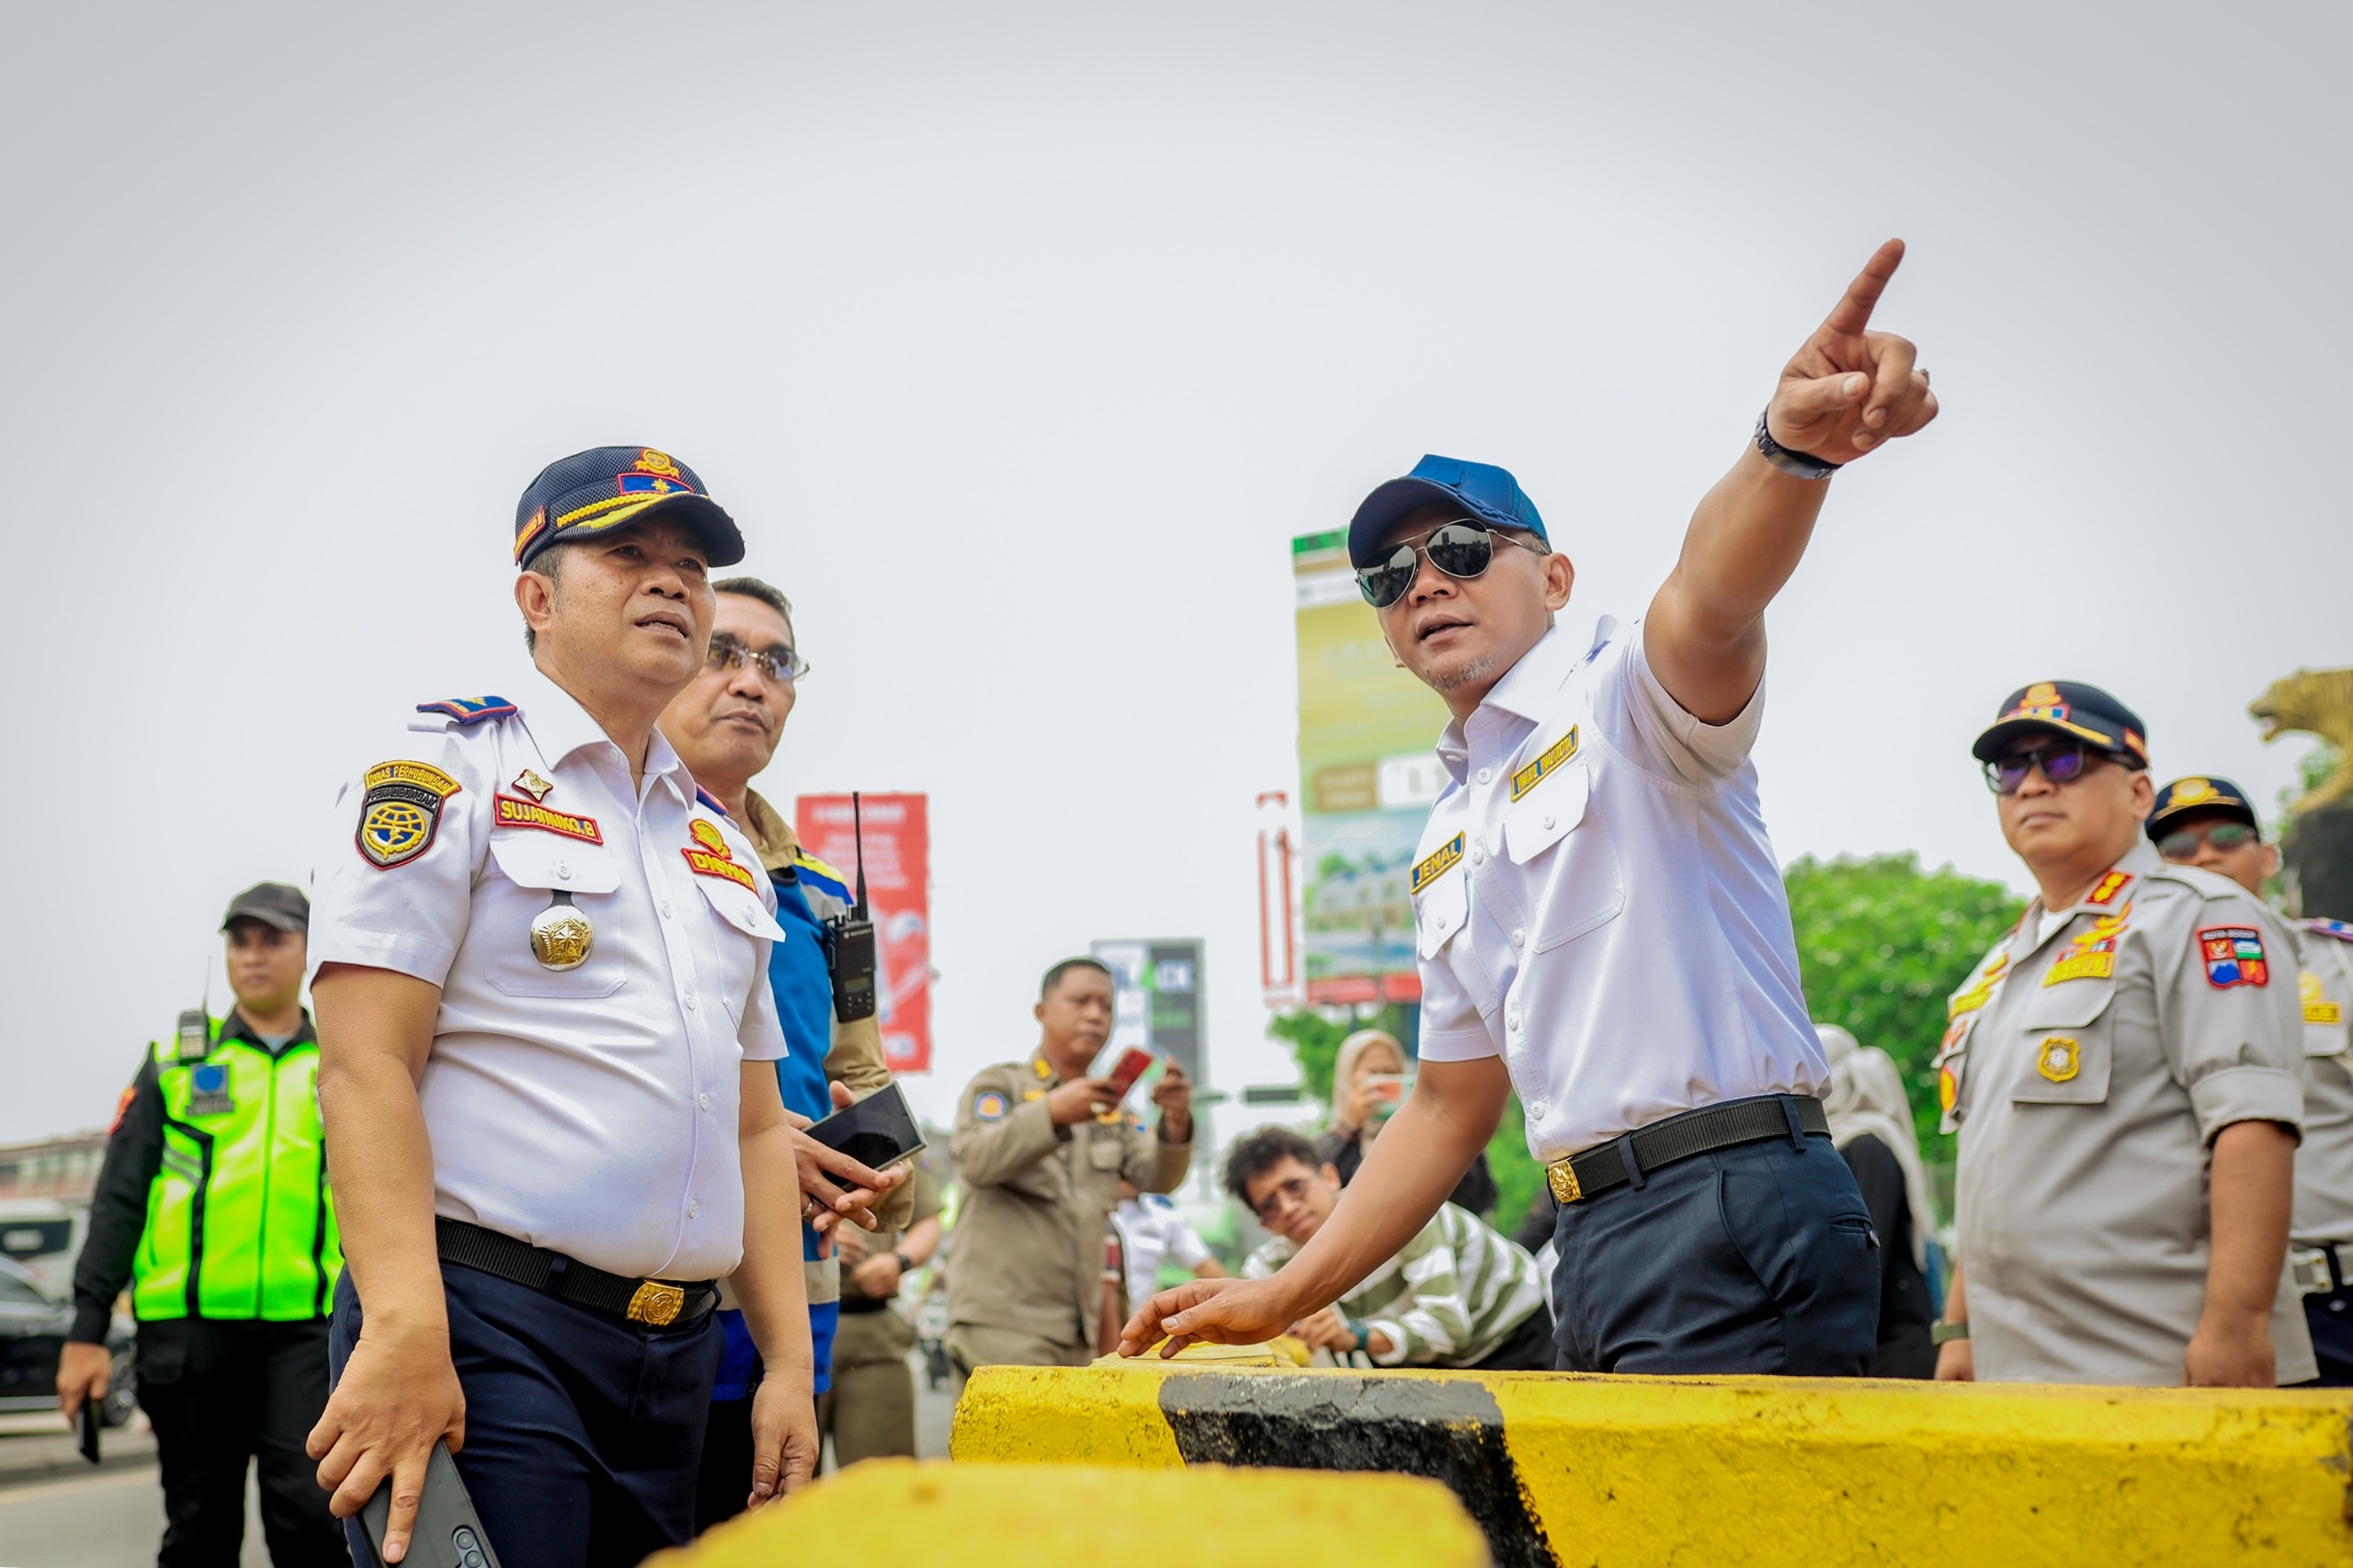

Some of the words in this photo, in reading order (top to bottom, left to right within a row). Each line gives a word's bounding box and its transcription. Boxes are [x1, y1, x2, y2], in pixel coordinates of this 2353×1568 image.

[369, 767, 392, 784] DINAS
[393, 765, 452, 791] PERHUBUNGAN
[369, 787, 438, 806] PERHUBUNGAN
[1416, 841, 1459, 885] JENAL
